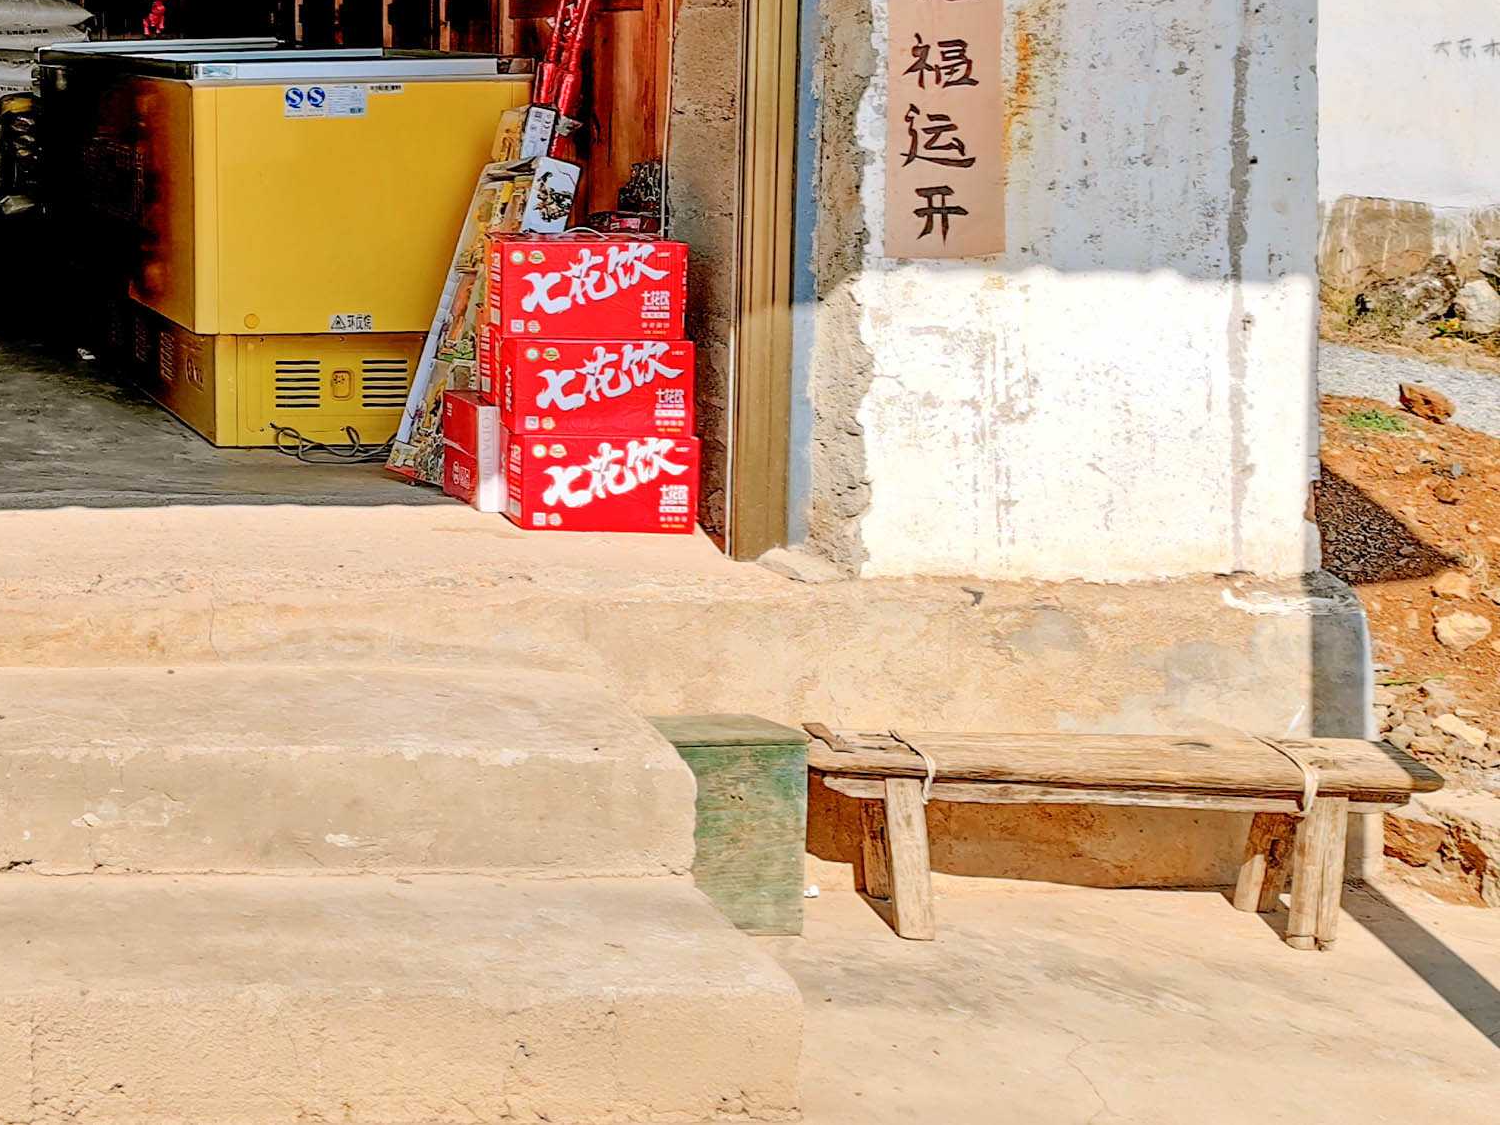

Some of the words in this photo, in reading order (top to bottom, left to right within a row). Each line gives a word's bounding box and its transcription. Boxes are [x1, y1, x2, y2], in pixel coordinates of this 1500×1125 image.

[521, 242, 670, 314] 七花饮
[536, 341, 685, 411] 七花饮
[542, 437, 689, 507] 七花饮
